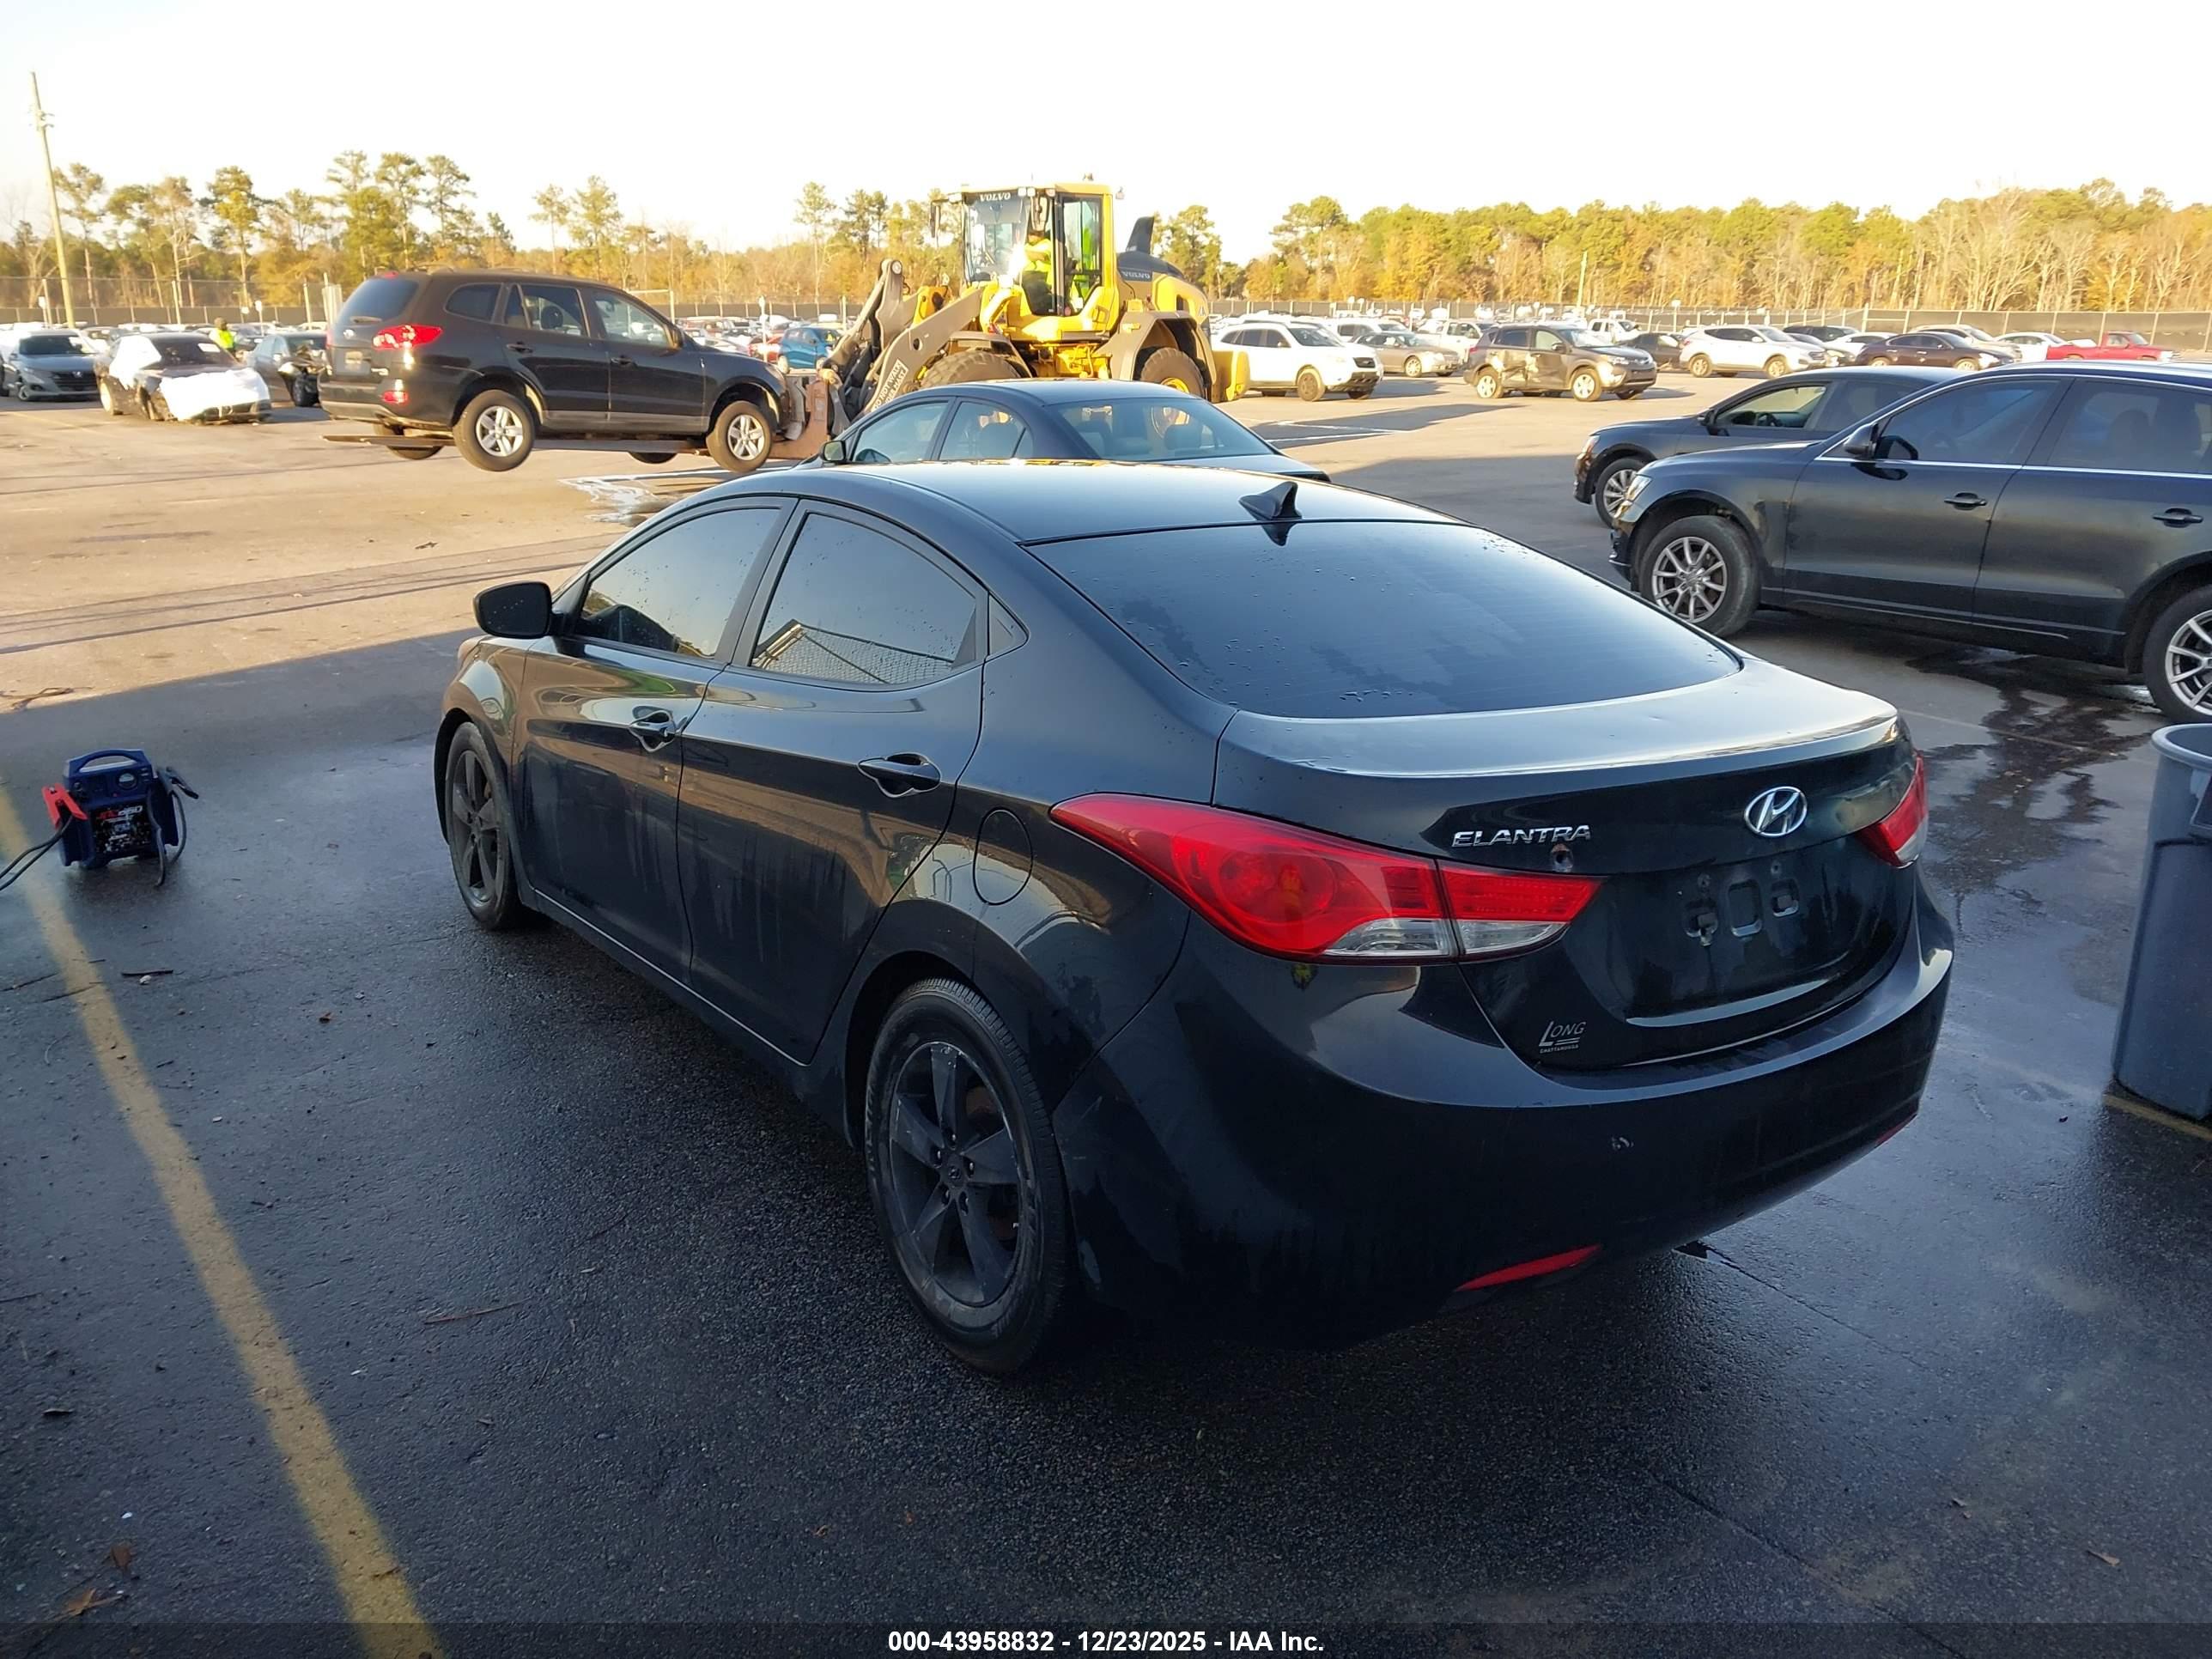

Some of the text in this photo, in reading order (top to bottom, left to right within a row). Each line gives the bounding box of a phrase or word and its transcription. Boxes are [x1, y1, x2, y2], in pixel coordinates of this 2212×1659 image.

[979, 192, 1012, 202] VOLVO
[1121, 270, 1151, 279] VOLVO
[879, 382, 890, 400] NOT
[888, 361, 902, 385] WALK
[893, 368, 906, 391] MAST
[1452, 824, 1590, 848] ELANTRA
[1538, 1021, 1587, 1047] LONG
